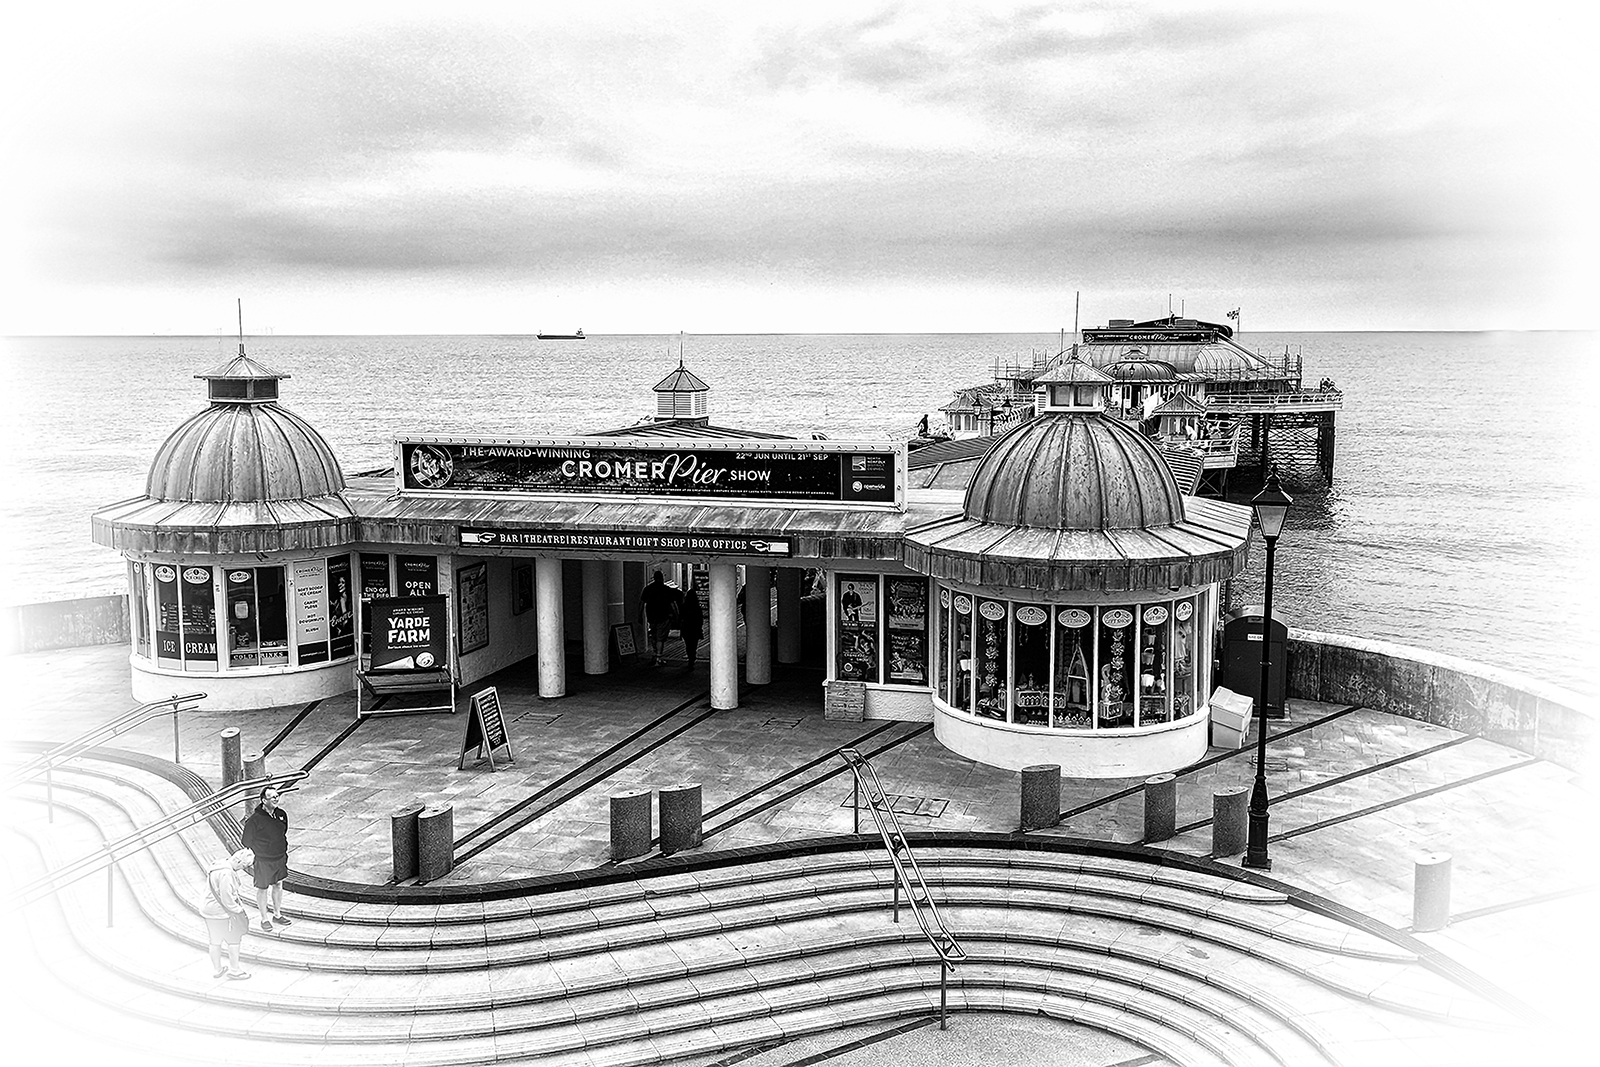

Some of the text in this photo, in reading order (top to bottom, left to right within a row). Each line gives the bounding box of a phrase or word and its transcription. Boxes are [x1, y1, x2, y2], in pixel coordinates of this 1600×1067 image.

[462, 447, 591, 458] THE AWARD-WINNING
[772, 453, 796, 461] UNTIL
[813, 453, 829, 461] SEP
[561, 453, 771, 484] CROMER Pier SHOW
[500, 534, 748, 550] BAR THEATRE RESTAURANT GIFT SHOP BOX OFFICE
[405, 581, 431, 589] OPEN
[387, 616, 430, 629] YARDE
[388, 628, 430, 643] FARM
[162, 639, 216, 654] ICE CREAM
[233, 653, 253, 661] COLD
